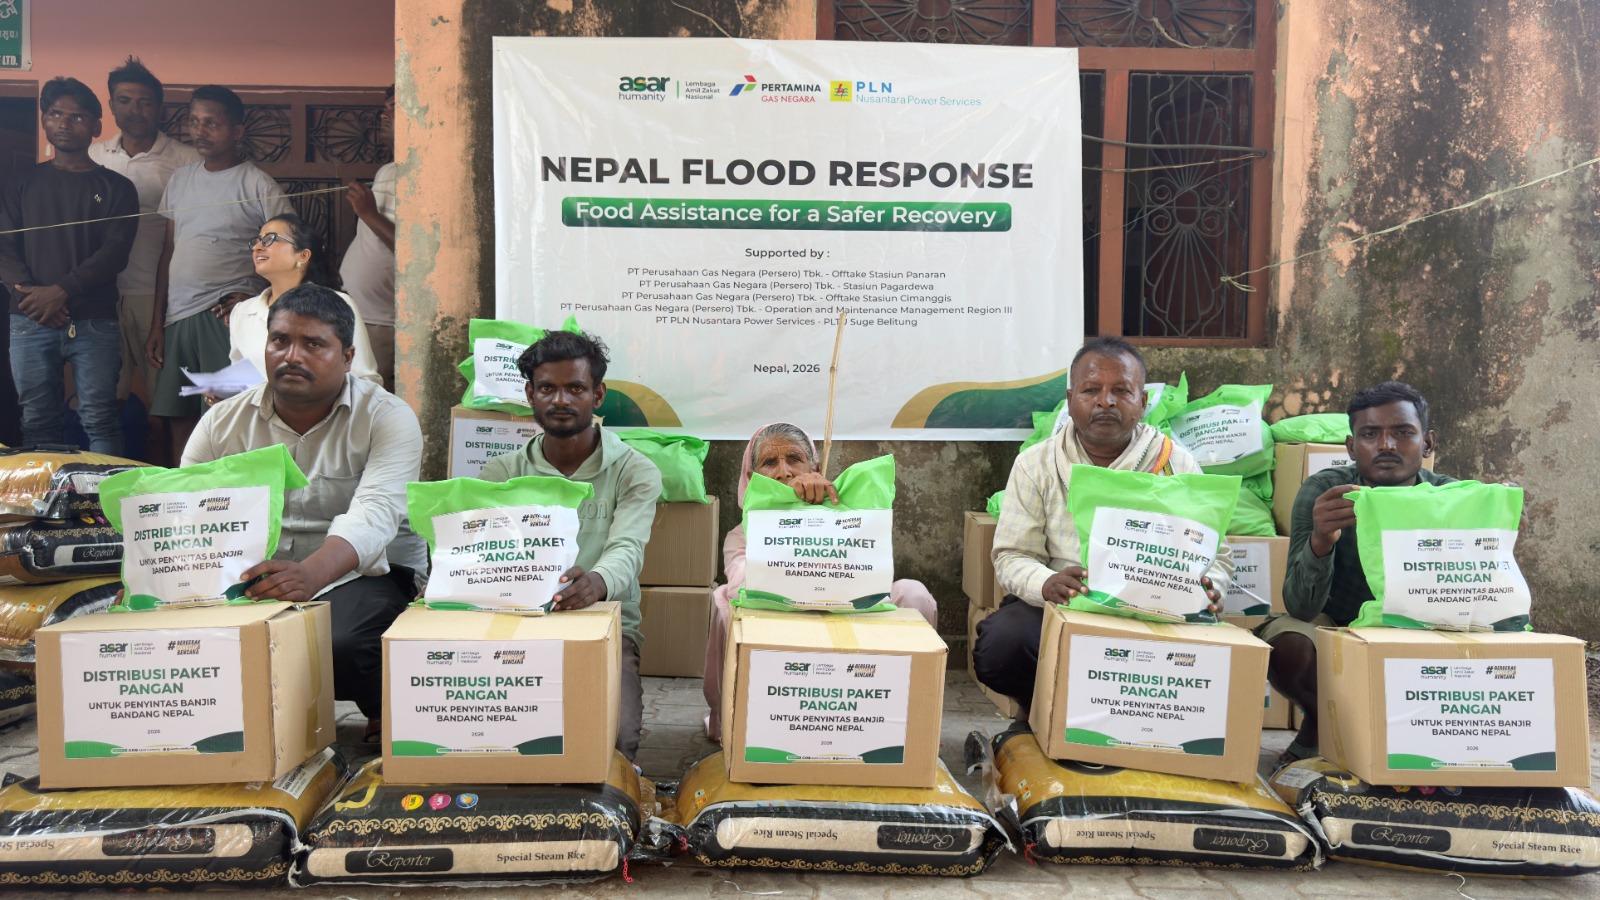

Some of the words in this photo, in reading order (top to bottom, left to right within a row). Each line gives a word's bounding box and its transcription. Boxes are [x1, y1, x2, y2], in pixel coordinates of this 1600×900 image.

[2, 55, 18, 66] LTD.
[619, 77, 670, 92] asar
[762, 84, 821, 92] PERTAMINA
[857, 81, 892, 93] PLN
[619, 92, 665, 101] humanity
[761, 95, 778, 103] GAS
[856, 94, 905, 104] Nusantara
[908, 95, 937, 105] Power
[939, 96, 982, 106] Services
[542, 156, 669, 184] NEPAL
[683, 159, 815, 185] FLOOD
[829, 161, 1033, 188] RESPONSE
[576, 202, 633, 219] Food
[640, 202, 762, 221] Assistance
[769, 204, 801, 221] for
[808, 209, 819, 222] a
[827, 205, 885, 222] Safer
[893, 205, 997, 227] Recovery
[745, 248, 806, 259] Supported
[810, 249, 824, 259] by
[642, 268, 699, 276] Perusahaan
[722, 269, 755, 278] Negara
[759, 270, 800, 278] (Persero)
[832, 270, 866, 278] Offtake
[654, 280, 710, 288] Perusahaan
[733, 281, 767, 290] Negara
[770, 281, 812, 291] (Persero)
[843, 282, 877, 290] Stasiun
[881, 283, 934, 292] Pagardewa
[637, 292, 693, 300] Perusahaan
[716, 294, 749, 302] Negara
[753, 293, 794, 303] (Persero)
[826, 294, 860, 302] Offtake
[900, 294, 952, 303] Cimanggis
[655, 305, 689, 313] Negara
[692, 304, 733, 314] (Persero)
[765, 305, 812, 314] Operation
[836, 306, 897, 315] Maintenance
[901, 306, 964, 315] Management
[968, 306, 1001, 315] Region
[1004, 306, 1012, 314] III
[744, 317, 773, 325] Power
[776, 317, 815, 325] Services
[850, 318, 874, 327] Suge
[877, 318, 917, 327] Belitung
[754, 364, 789, 374] Nepal,
[793, 364, 820, 372] 2026
[764, 537, 833, 546] DISTRIBUSI
[838, 538, 876, 548] PAKET
[794, 548, 847, 558] PANGAN
[798, 562, 842, 570] PENYINTAS
[99, 643, 128, 653] asar
[1105, 648, 1131, 657] asar
[427, 652, 455, 660] asar
[784, 662, 811, 671] asar
[1421, 666, 1448, 674] asar
[84, 669, 165, 682] DISTRIBUSI
[171, 667, 220, 679] PAKET
[1088, 670, 1163, 685] DISTRIBUSI
[1167, 677, 1211, 689] PAKET
[411, 676, 490, 687] DISTRIBUSI
[496, 676, 543, 687] PAKET
[120, 682, 183, 695] PANGAN
[768, 686, 843, 698] DISTRIBUSI
[847, 689, 891, 699] PAKET
[1120, 685, 1177, 699] PANGAN
[446, 690, 507, 700] PANGAN
[1406, 691, 1484, 701] DISTRIBUSI
[1489, 691, 1535, 701] PAKET
[124, 700, 178, 708] PENYINTAS
[181, 698, 216, 707] BANJIR
[800, 700, 857, 711] PANGAN
[1091, 697, 1120, 706] UNTUK
[1123, 700, 1171, 710] PENYINTAS
[1174, 705, 1205, 713] BANJIR
[111, 711, 160, 719] BANDANG
[163, 709, 194, 717] NEPAL
[1110, 708, 1154, 718] BANDANG
[1157, 712, 1184, 720] NEPAL
[1441, 704, 1501, 714] PANGAN
[770, 714, 800, 722] UNTUK
[754, 829, 773, 838] Rice
[776, 830, 803, 839] Steam
[806, 829, 838, 840] Special
[1077, 831, 1095, 839] Rice
[1097, 831, 1123, 839] Steam
[1126, 831, 1156, 840] Special
[1370, 826, 1433, 845] Reporter
[1491, 840, 1525, 851] Special
[1528, 843, 1556, 852] Steam
[1559, 845, 1581, 854] Rice
[366, 852, 434, 870] Reporter
[497, 853, 531, 864] Special
[567, 850, 585, 859] Rice
